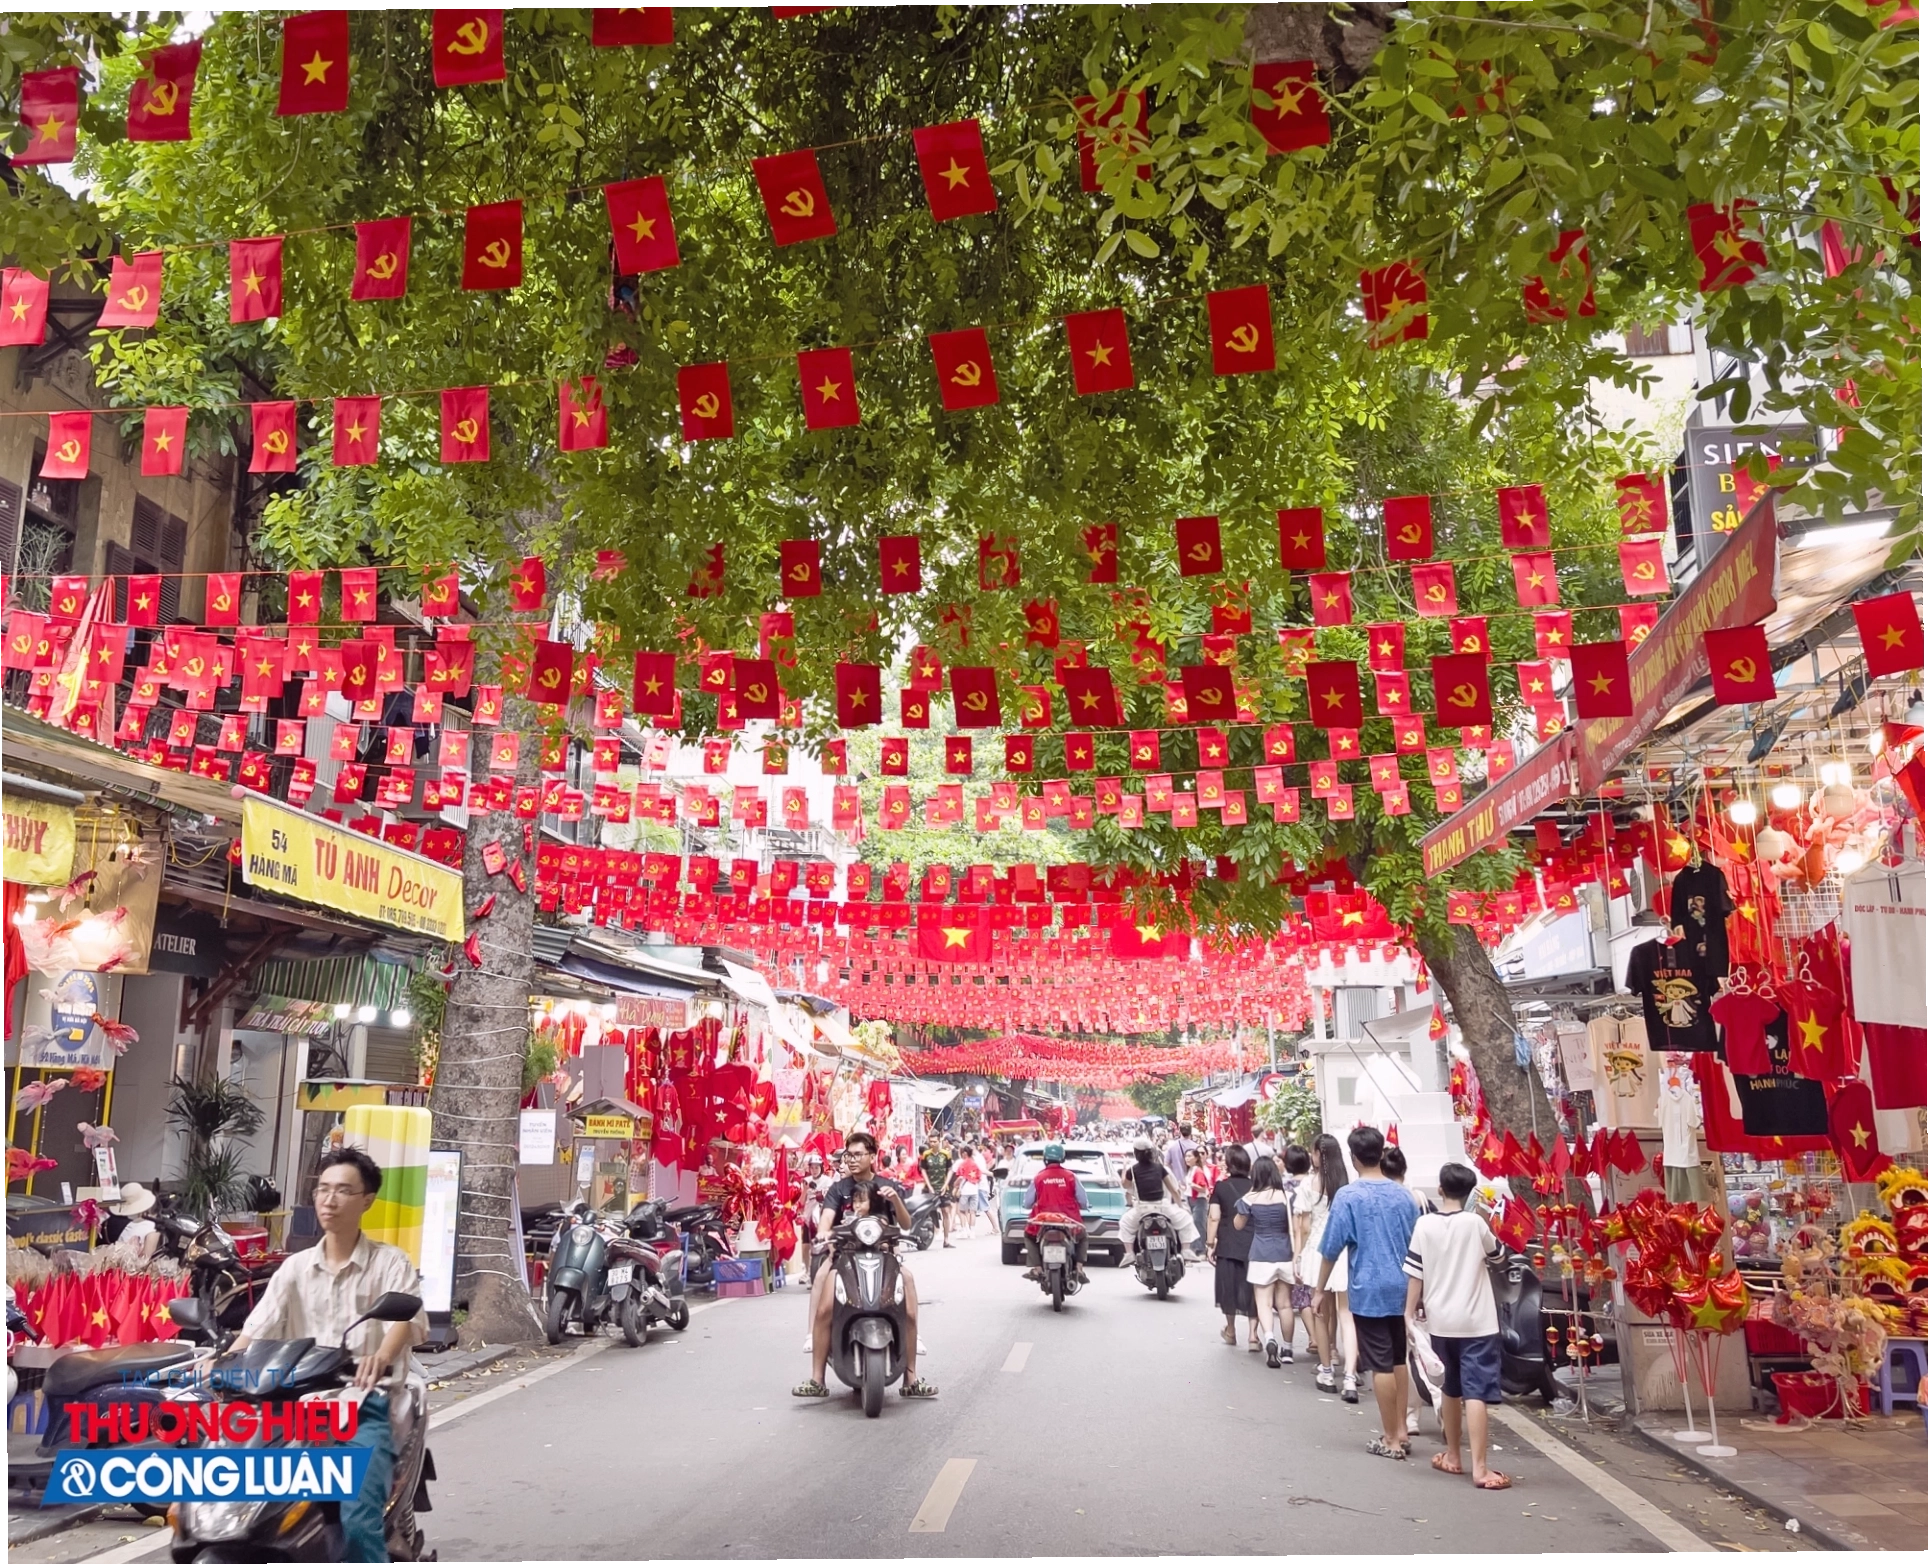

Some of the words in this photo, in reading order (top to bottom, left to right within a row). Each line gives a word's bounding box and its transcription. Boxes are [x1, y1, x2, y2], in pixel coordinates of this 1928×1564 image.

[271, 828, 288, 853] 54
[1428, 827, 1466, 873] THANH
[1467, 798, 1496, 847] THƯ
[249, 854, 280, 879] HÀNG
[282, 863, 298, 887] MÃ
[315, 835, 338, 881] TÚ
[343, 849, 381, 895] ANH
[387, 865, 438, 910] Decor
[154, 932, 197, 956] ATELIER
[1622, 1042, 1641, 1051] NAM
[1043, 1177, 1066, 1185] viettel
